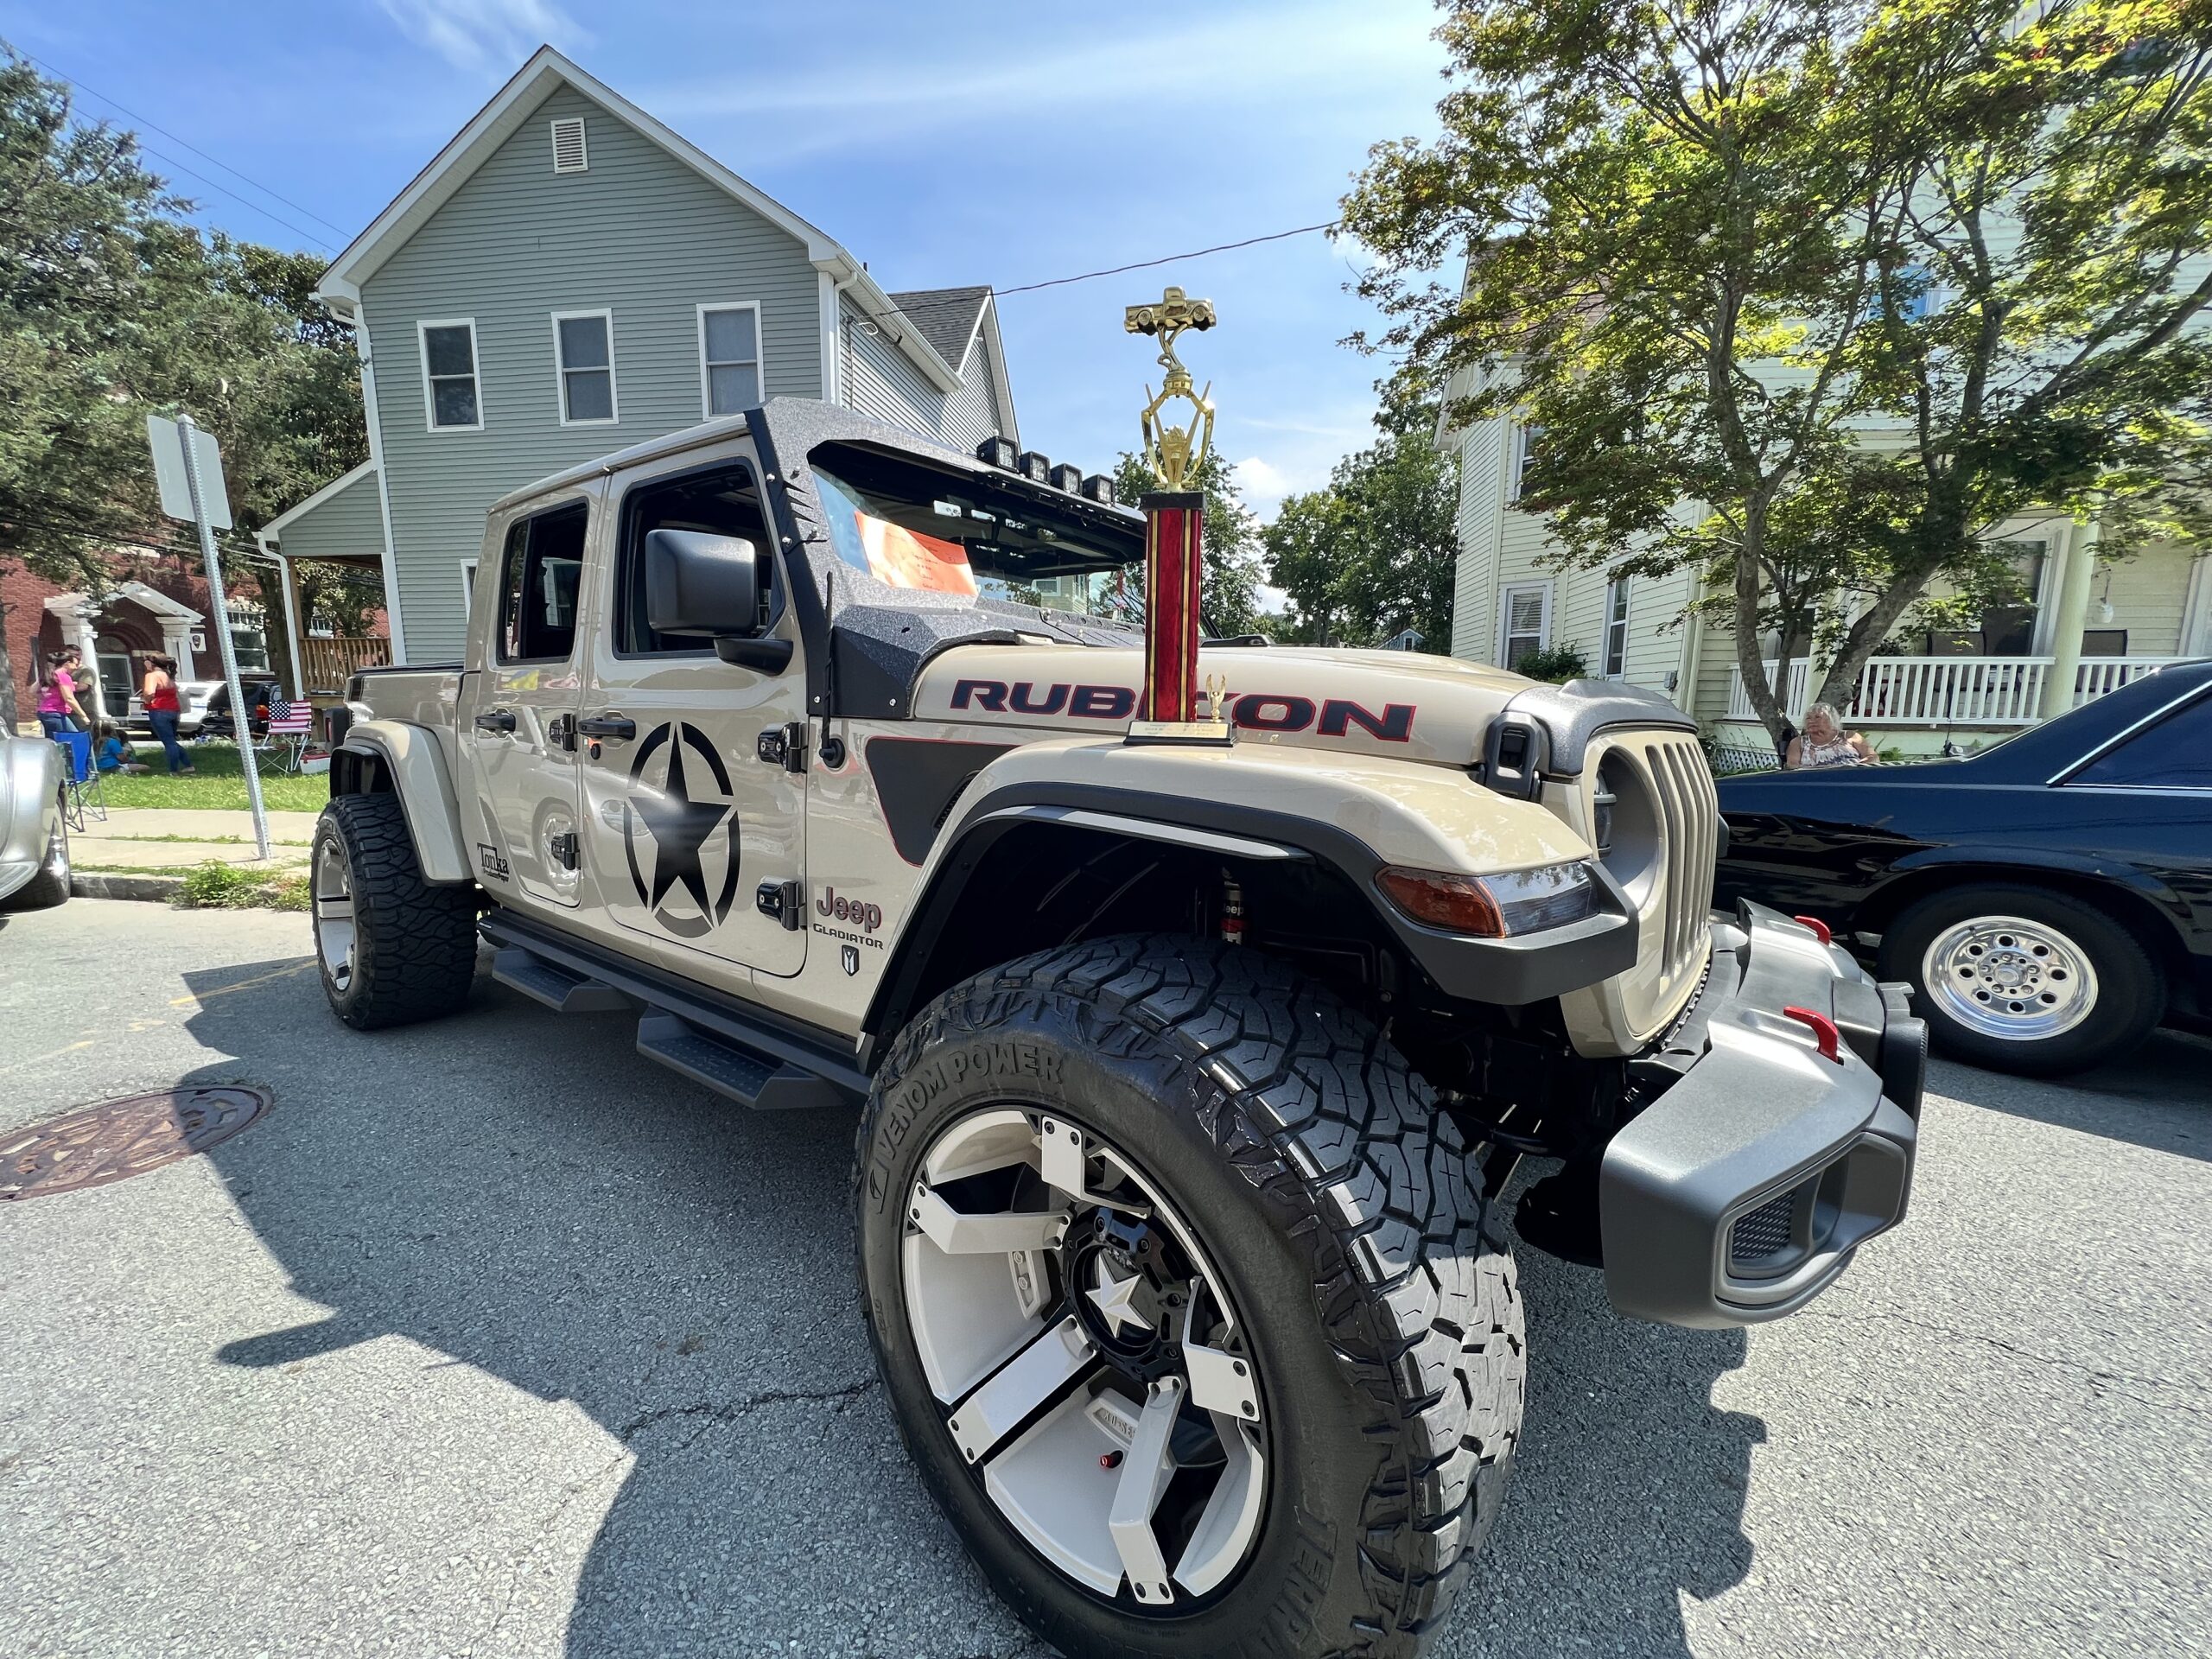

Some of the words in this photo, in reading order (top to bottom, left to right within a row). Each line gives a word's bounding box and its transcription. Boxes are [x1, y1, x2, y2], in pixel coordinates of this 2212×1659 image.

[950, 679, 1417, 743] RUBON
[477, 842, 509, 874] Tonka
[817, 886, 881, 933] Jeep
[813, 923, 883, 950] GLADIATOR
[876, 1061, 949, 1161] VENOM
[949, 1042, 1068, 1084] POWER
